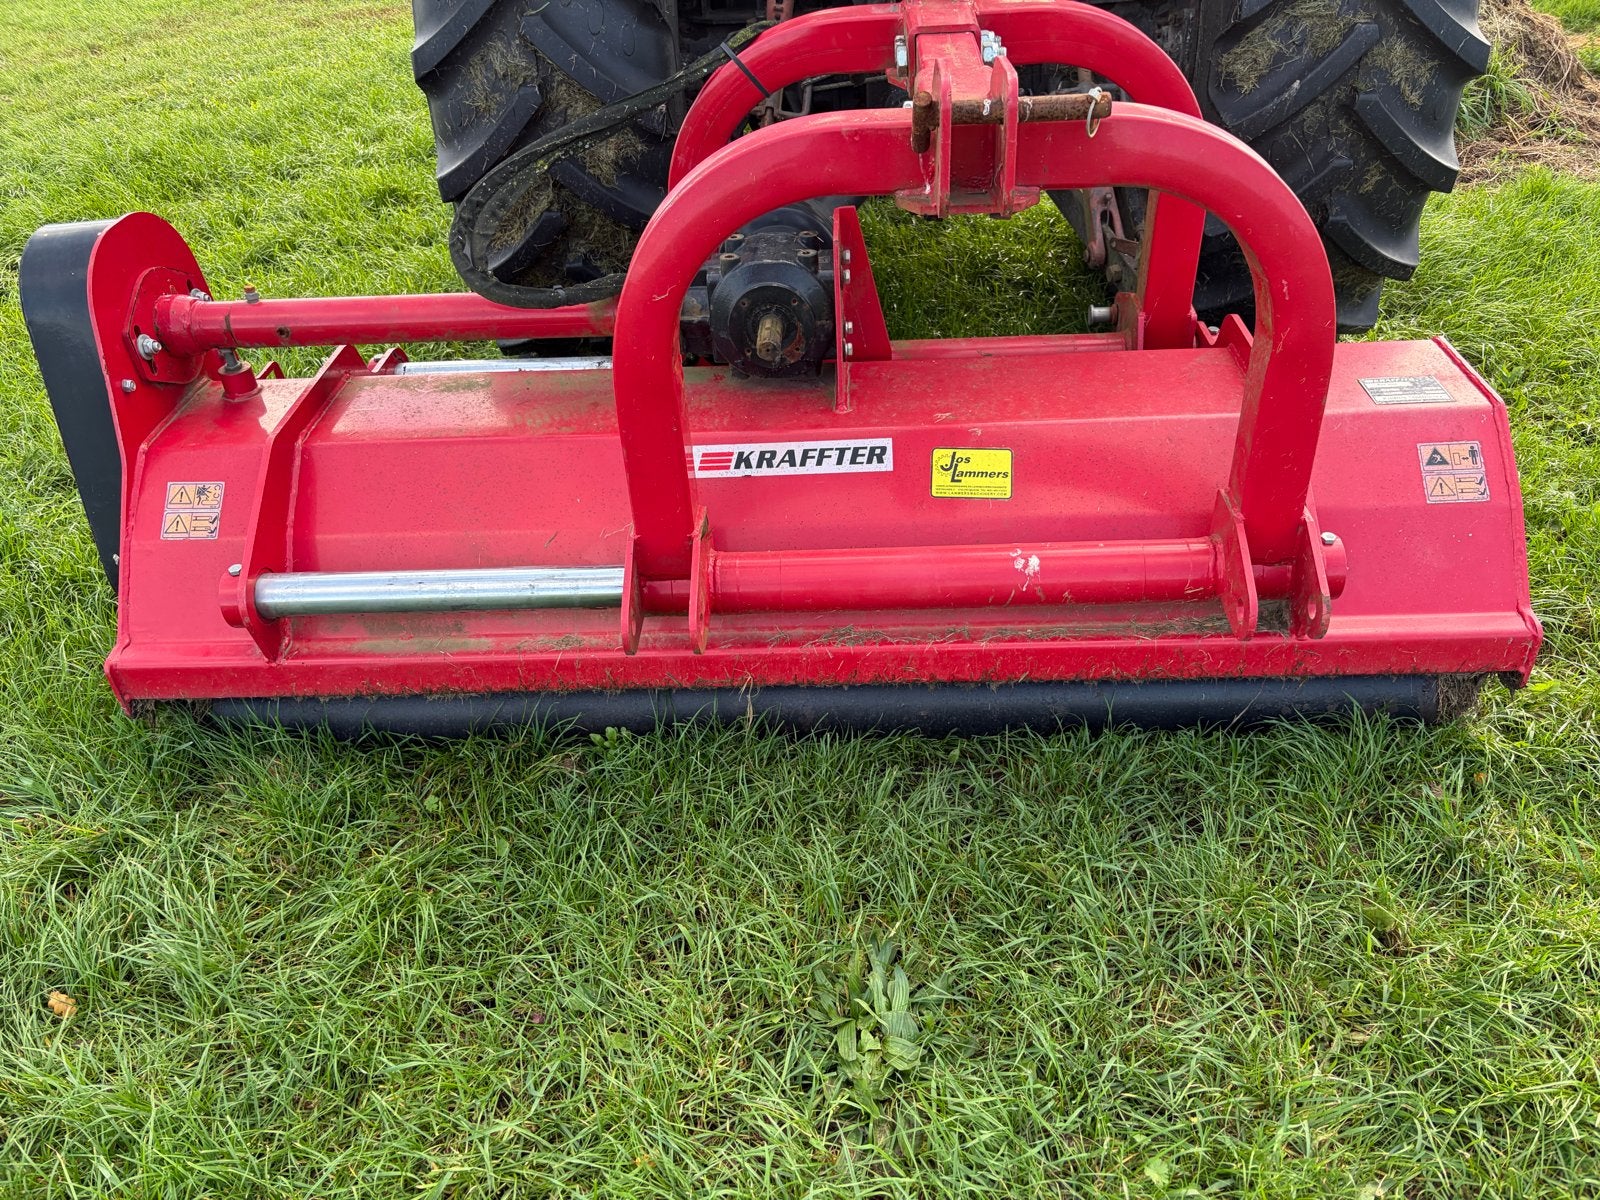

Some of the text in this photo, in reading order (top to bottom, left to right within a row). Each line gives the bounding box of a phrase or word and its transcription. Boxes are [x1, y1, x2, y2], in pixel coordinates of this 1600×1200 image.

[733, 445, 888, 470] KRAFFTER
[940, 451, 971, 472] Jos
[950, 463, 1009, 483] Lammers
